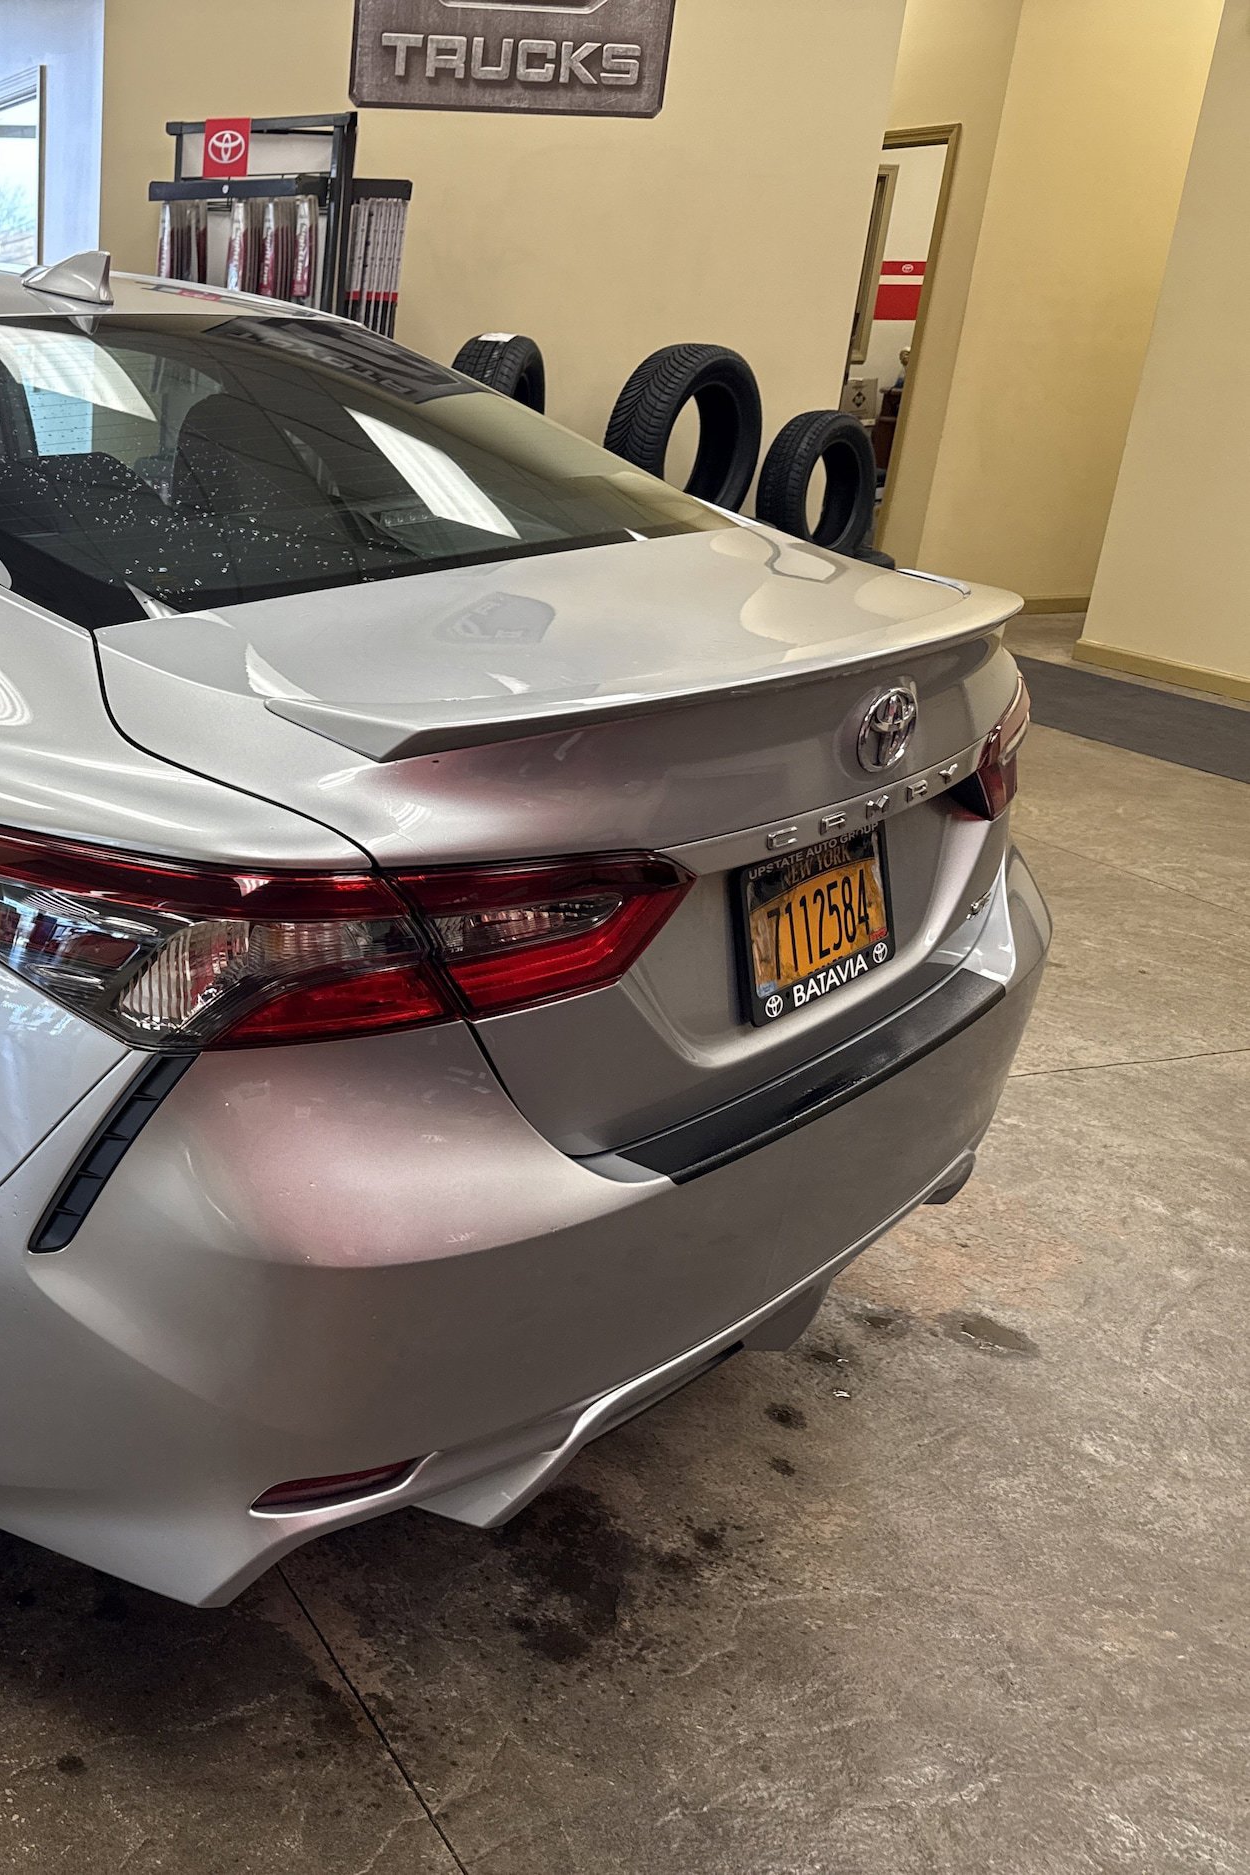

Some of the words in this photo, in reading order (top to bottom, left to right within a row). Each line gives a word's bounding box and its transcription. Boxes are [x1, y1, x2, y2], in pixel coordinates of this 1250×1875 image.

[381, 32, 642, 86] TRUCKS
[767, 763, 958, 850] CAMRY
[748, 850, 803, 881] UPSTATE
[805, 837, 838, 858] AUTO
[839, 822, 879, 844] GROUP
[814, 845, 851, 873] YORK
[767, 868, 870, 980] 7112584
[792, 953, 869, 1008] BATAVIA
